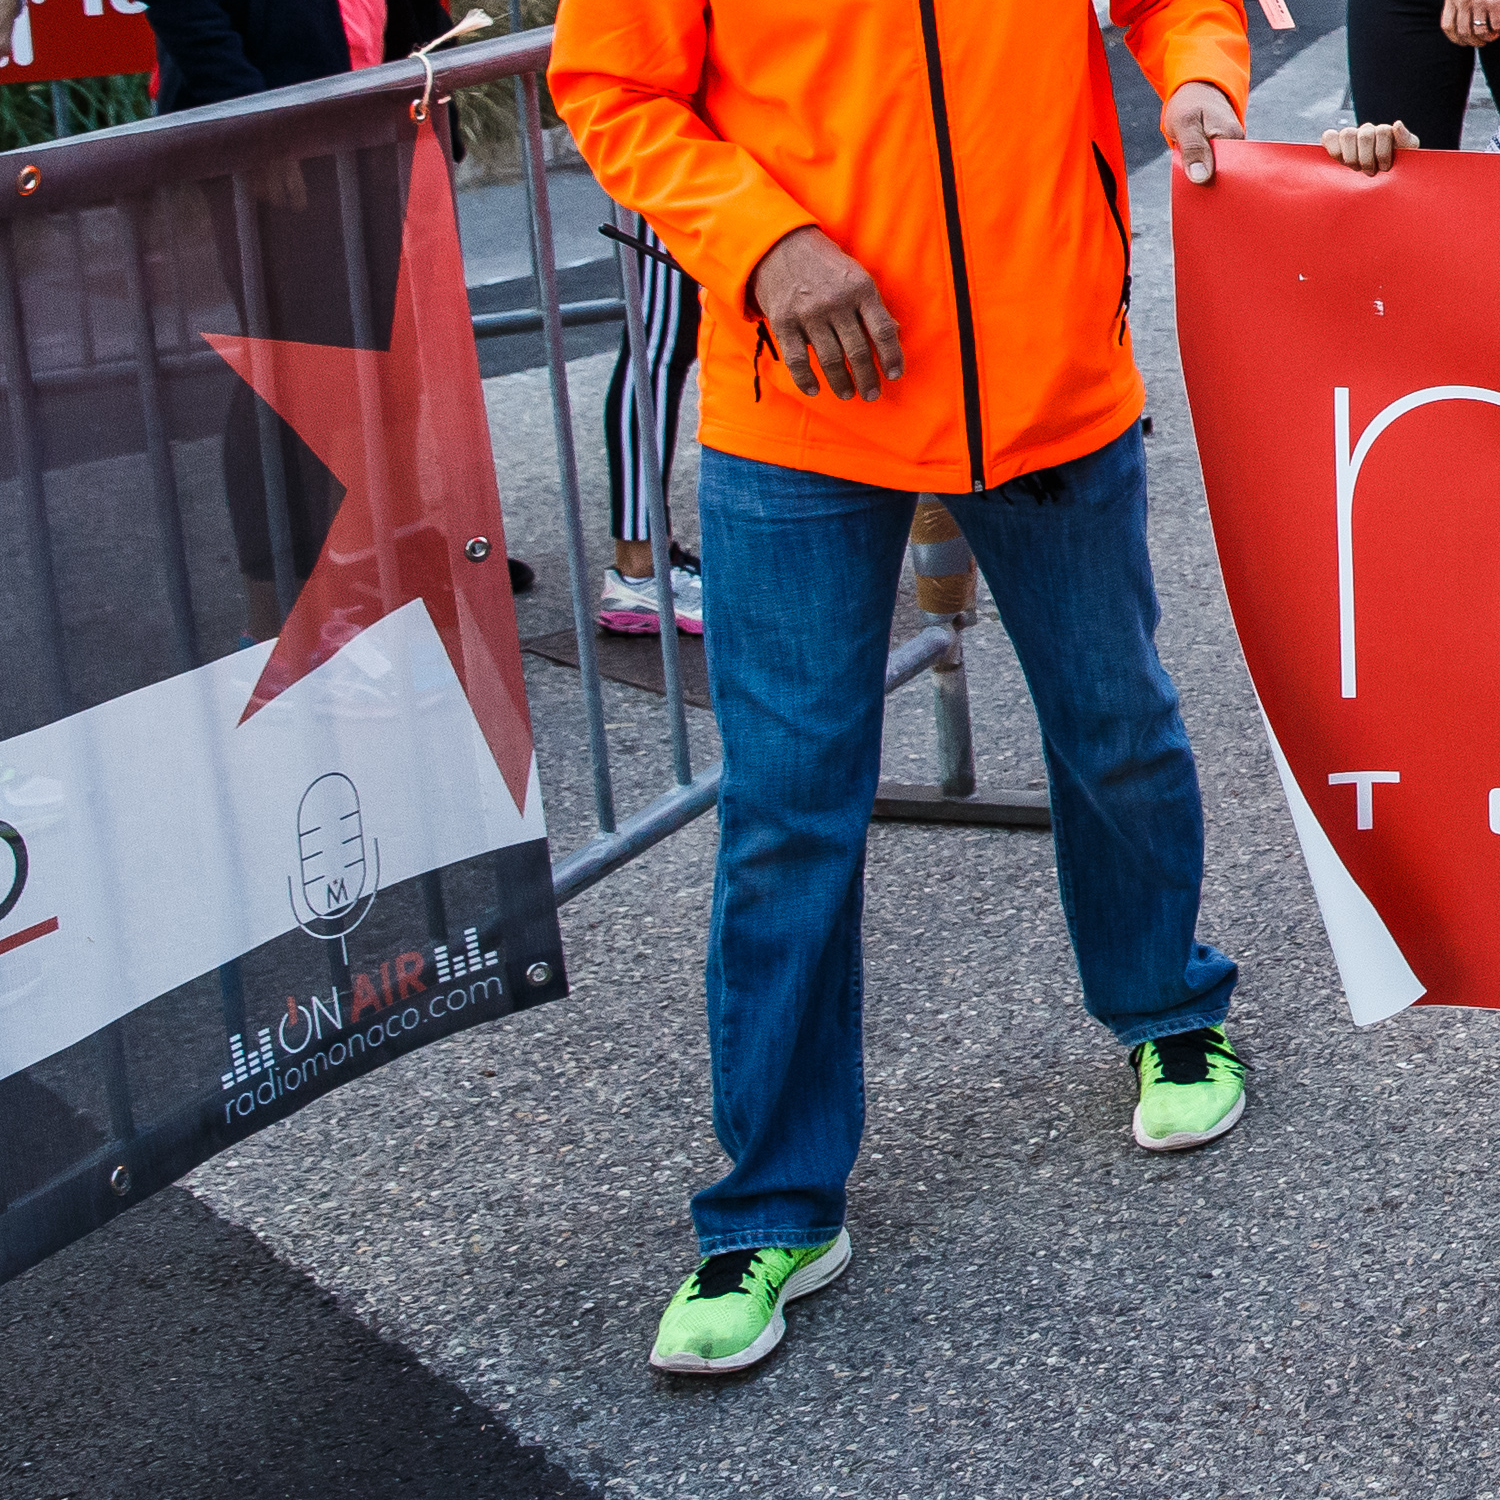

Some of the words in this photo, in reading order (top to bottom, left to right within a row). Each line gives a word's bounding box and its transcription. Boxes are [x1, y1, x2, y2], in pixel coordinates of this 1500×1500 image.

[224, 976, 504, 1124] radiomonaco.com
[278, 986, 342, 1054] ON
[351, 950, 427, 1024] AIR
